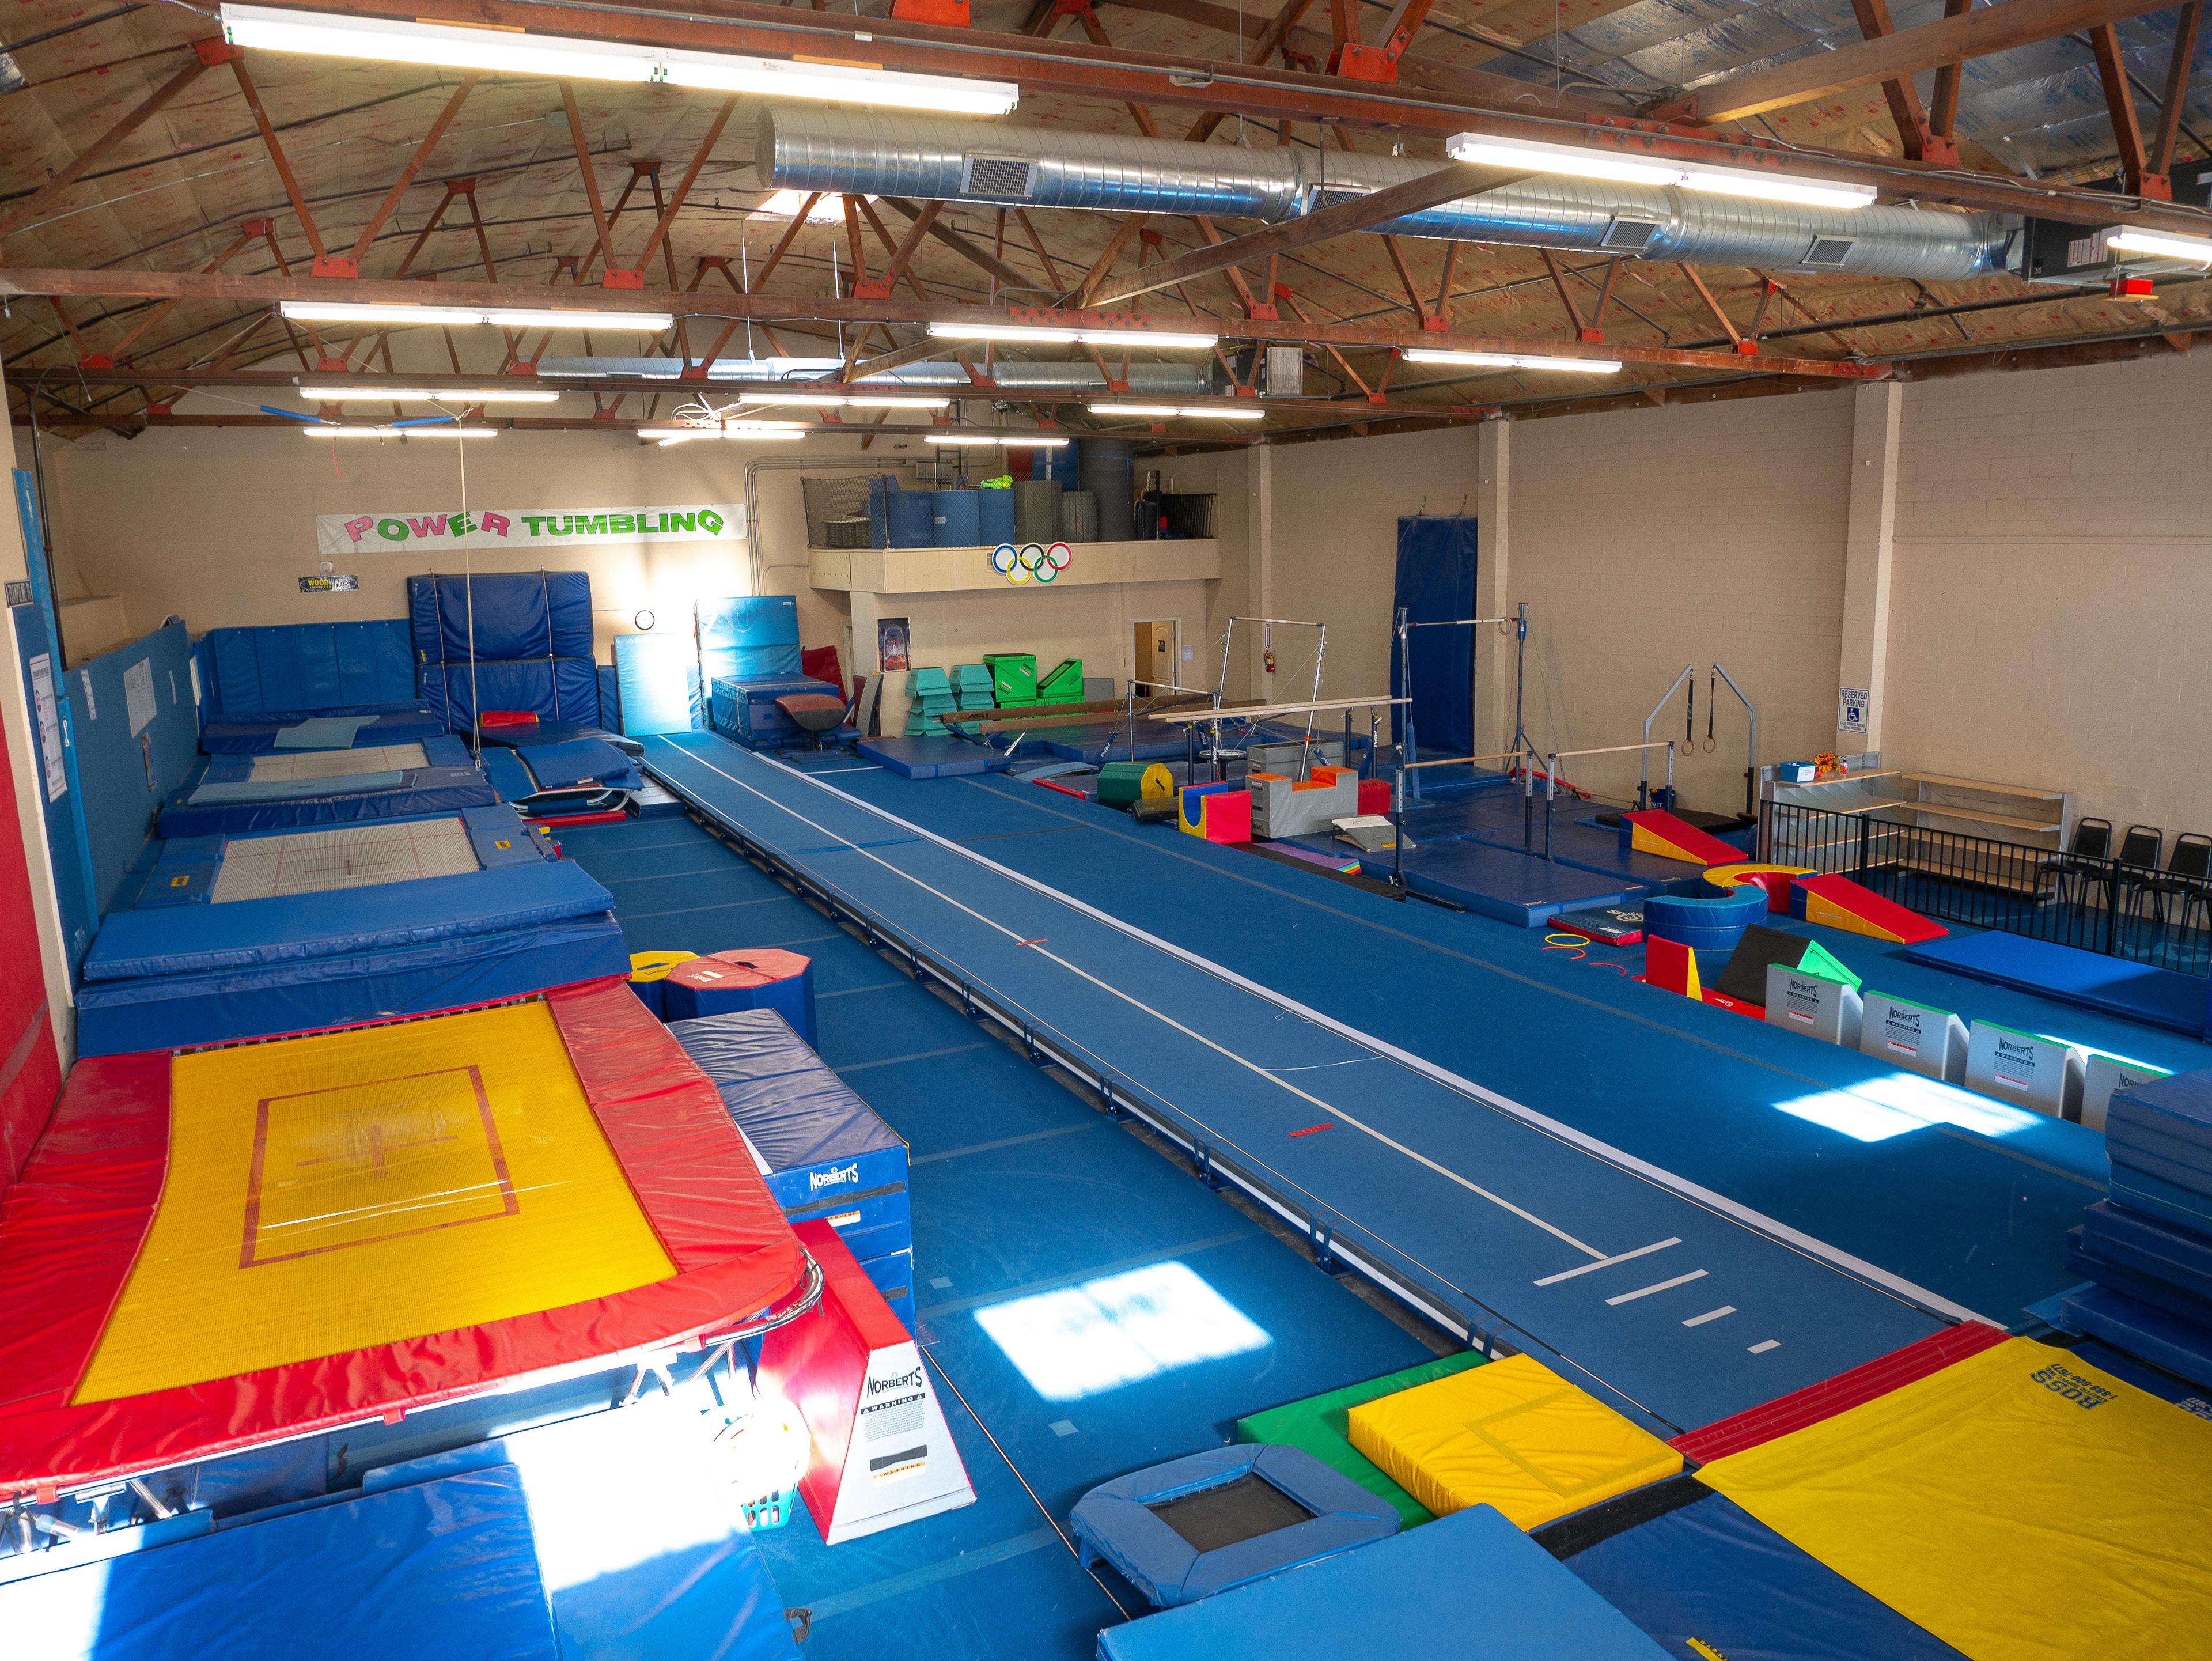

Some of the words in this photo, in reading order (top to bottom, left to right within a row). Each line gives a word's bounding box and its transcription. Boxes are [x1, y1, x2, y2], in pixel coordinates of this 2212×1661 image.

[344, 511, 510, 543] POWER
[521, 509, 724, 537] TUMBLING
[1841, 690, 1868, 700] RESERVED
[1843, 698, 1865, 707] PARKING
[1790, 978, 1817, 998] NORBERTS
[1889, 1006, 1920, 1027] NORBERTS
[1999, 1036, 2034, 1060] NORBERTS
[809, 1163, 859, 1192] NORBERTS
[867, 1366, 922, 1398] NORBERTS
[2029, 1368, 2102, 1410] ROSS
[871, 1395, 914, 1411] WARNING
[883, 1463, 921, 1477] WARNING
